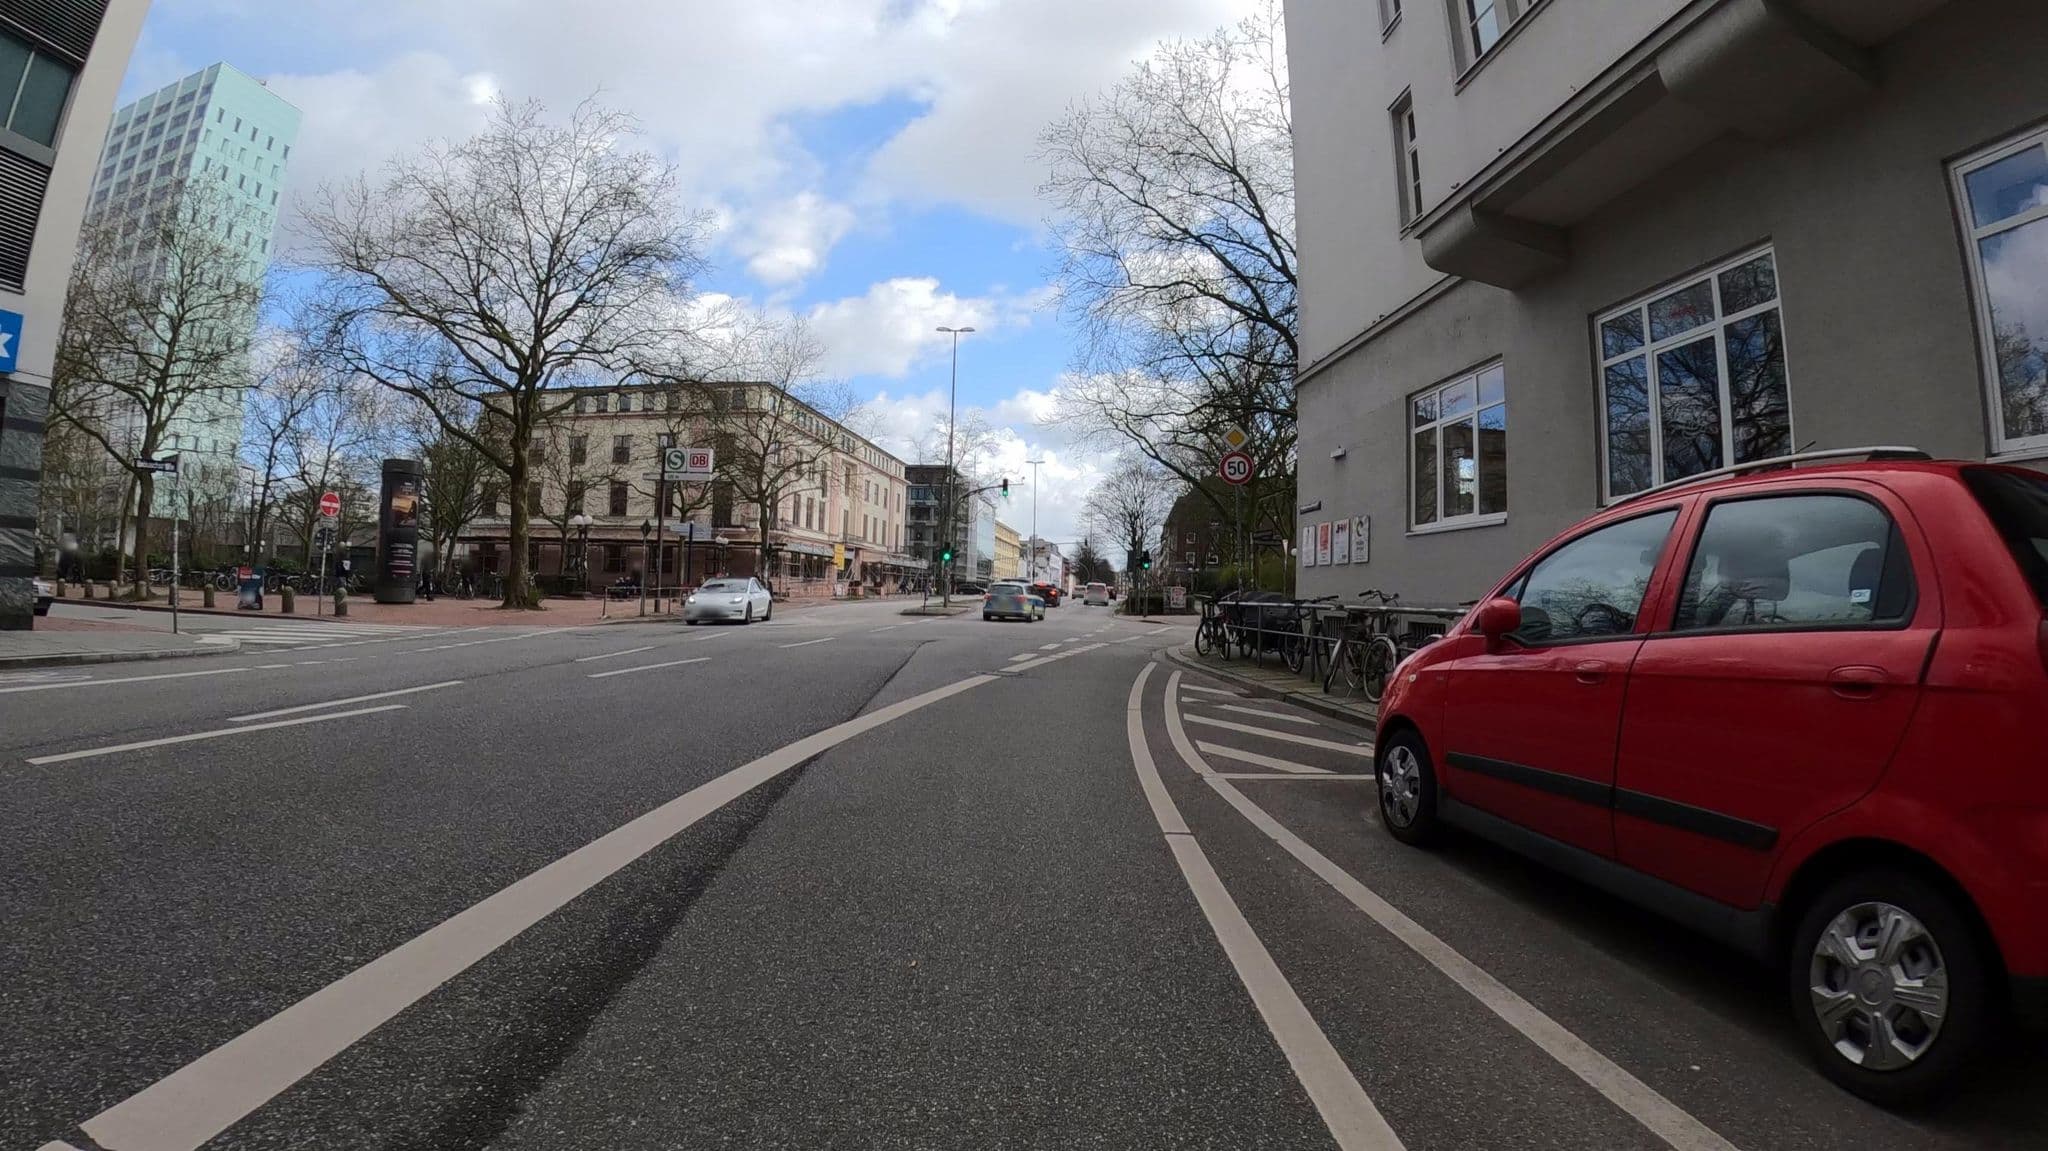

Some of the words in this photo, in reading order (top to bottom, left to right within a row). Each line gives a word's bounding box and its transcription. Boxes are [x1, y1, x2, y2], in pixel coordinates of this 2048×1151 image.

[668, 451, 684, 469] S
[692, 455, 706, 466] DB
[1228, 461, 1246, 476] 50
